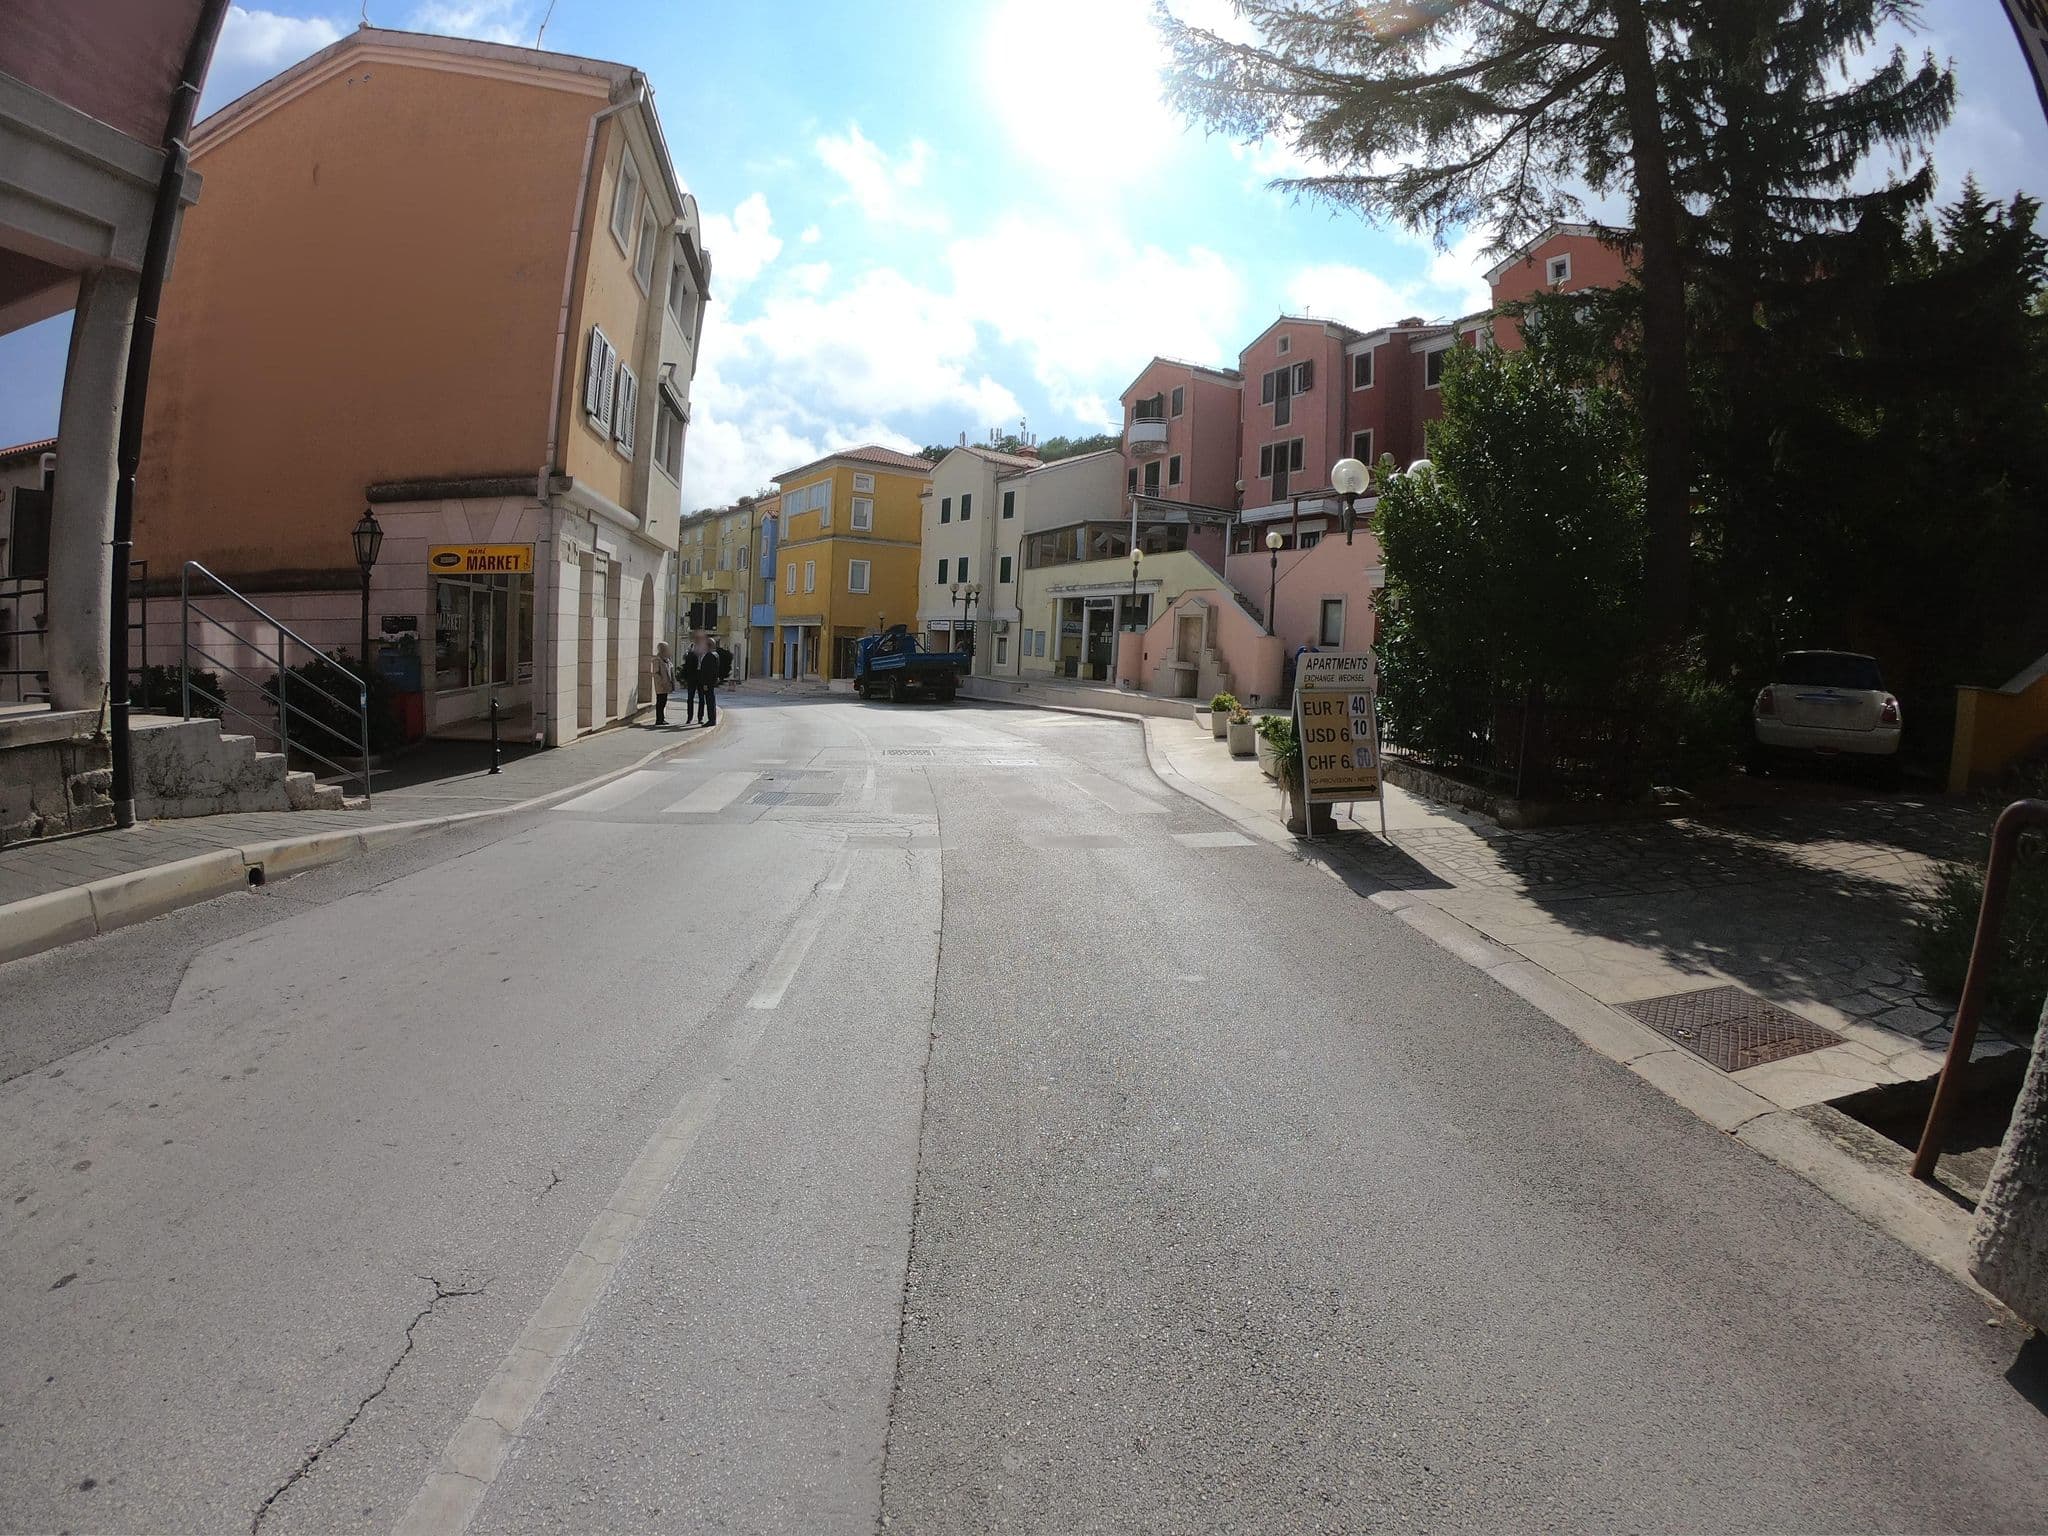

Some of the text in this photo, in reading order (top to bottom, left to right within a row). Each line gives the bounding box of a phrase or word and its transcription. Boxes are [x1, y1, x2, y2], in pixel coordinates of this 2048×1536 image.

[466, 555, 520, 570] MARKET
[1306, 657, 1368, 670] APARTMENTS
[1304, 674, 1365, 682] EXCHANGE WECHSEL
[1303, 701, 1332, 716] EUR
[1305, 728, 1336, 743] USD
[1308, 755, 1337, 770] CHF
